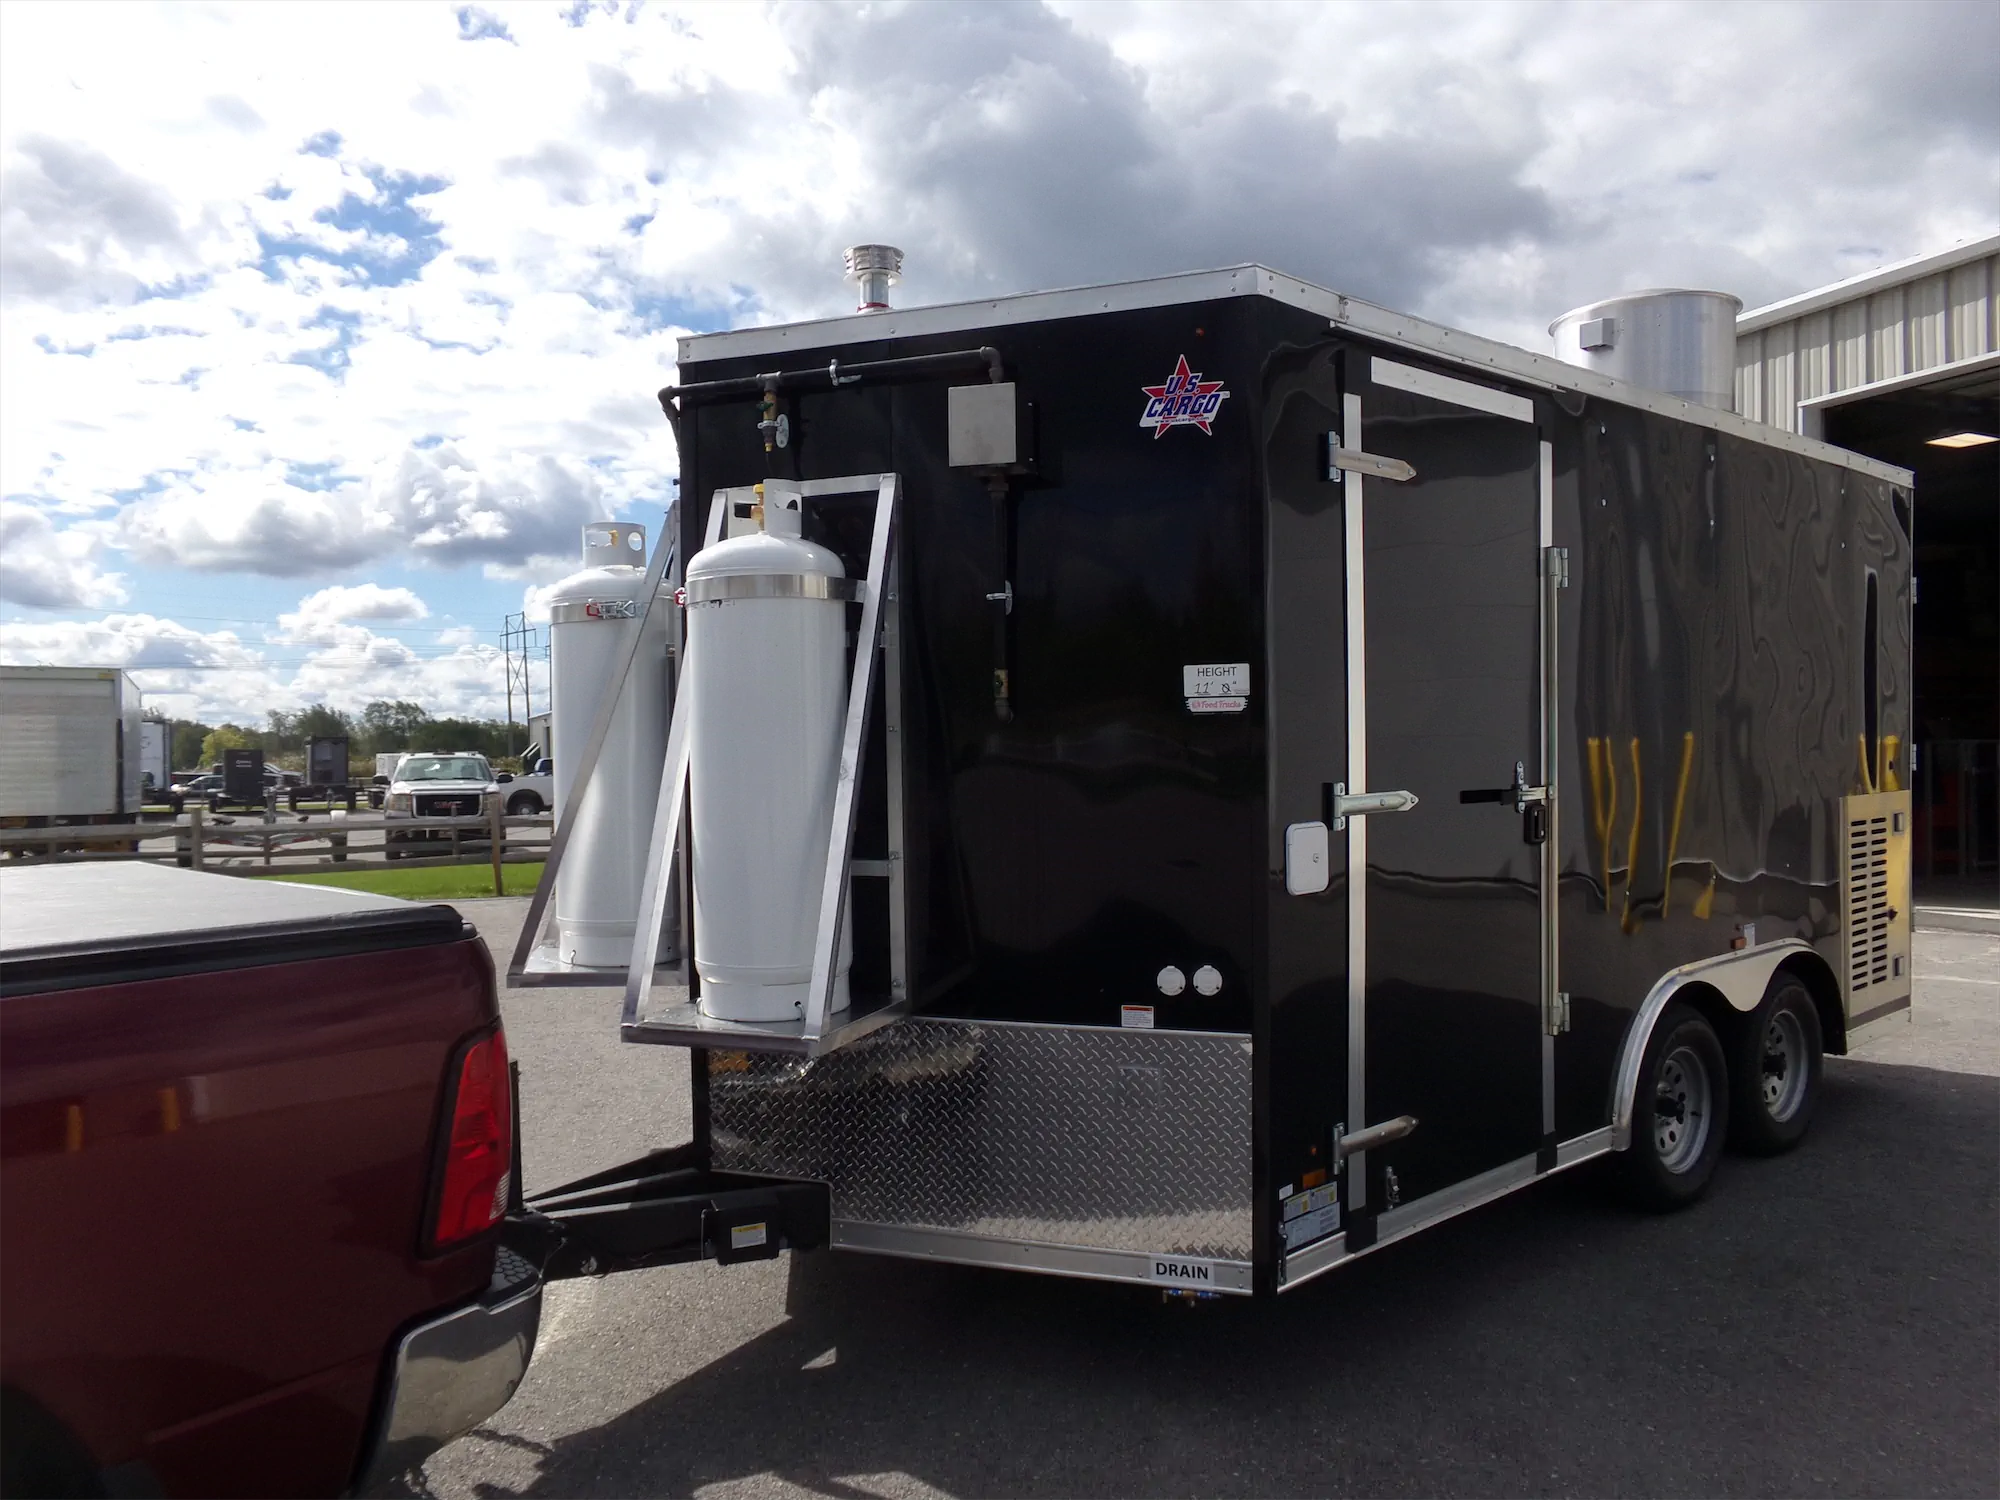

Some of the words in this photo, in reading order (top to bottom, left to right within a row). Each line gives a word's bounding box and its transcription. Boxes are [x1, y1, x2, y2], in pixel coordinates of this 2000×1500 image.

[1165, 375, 1201, 395] U.S.
[1146, 393, 1221, 418] CARGO
[1197, 666, 1237, 677] HEIGHT
[1156, 1262, 1209, 1280] DRAIN
